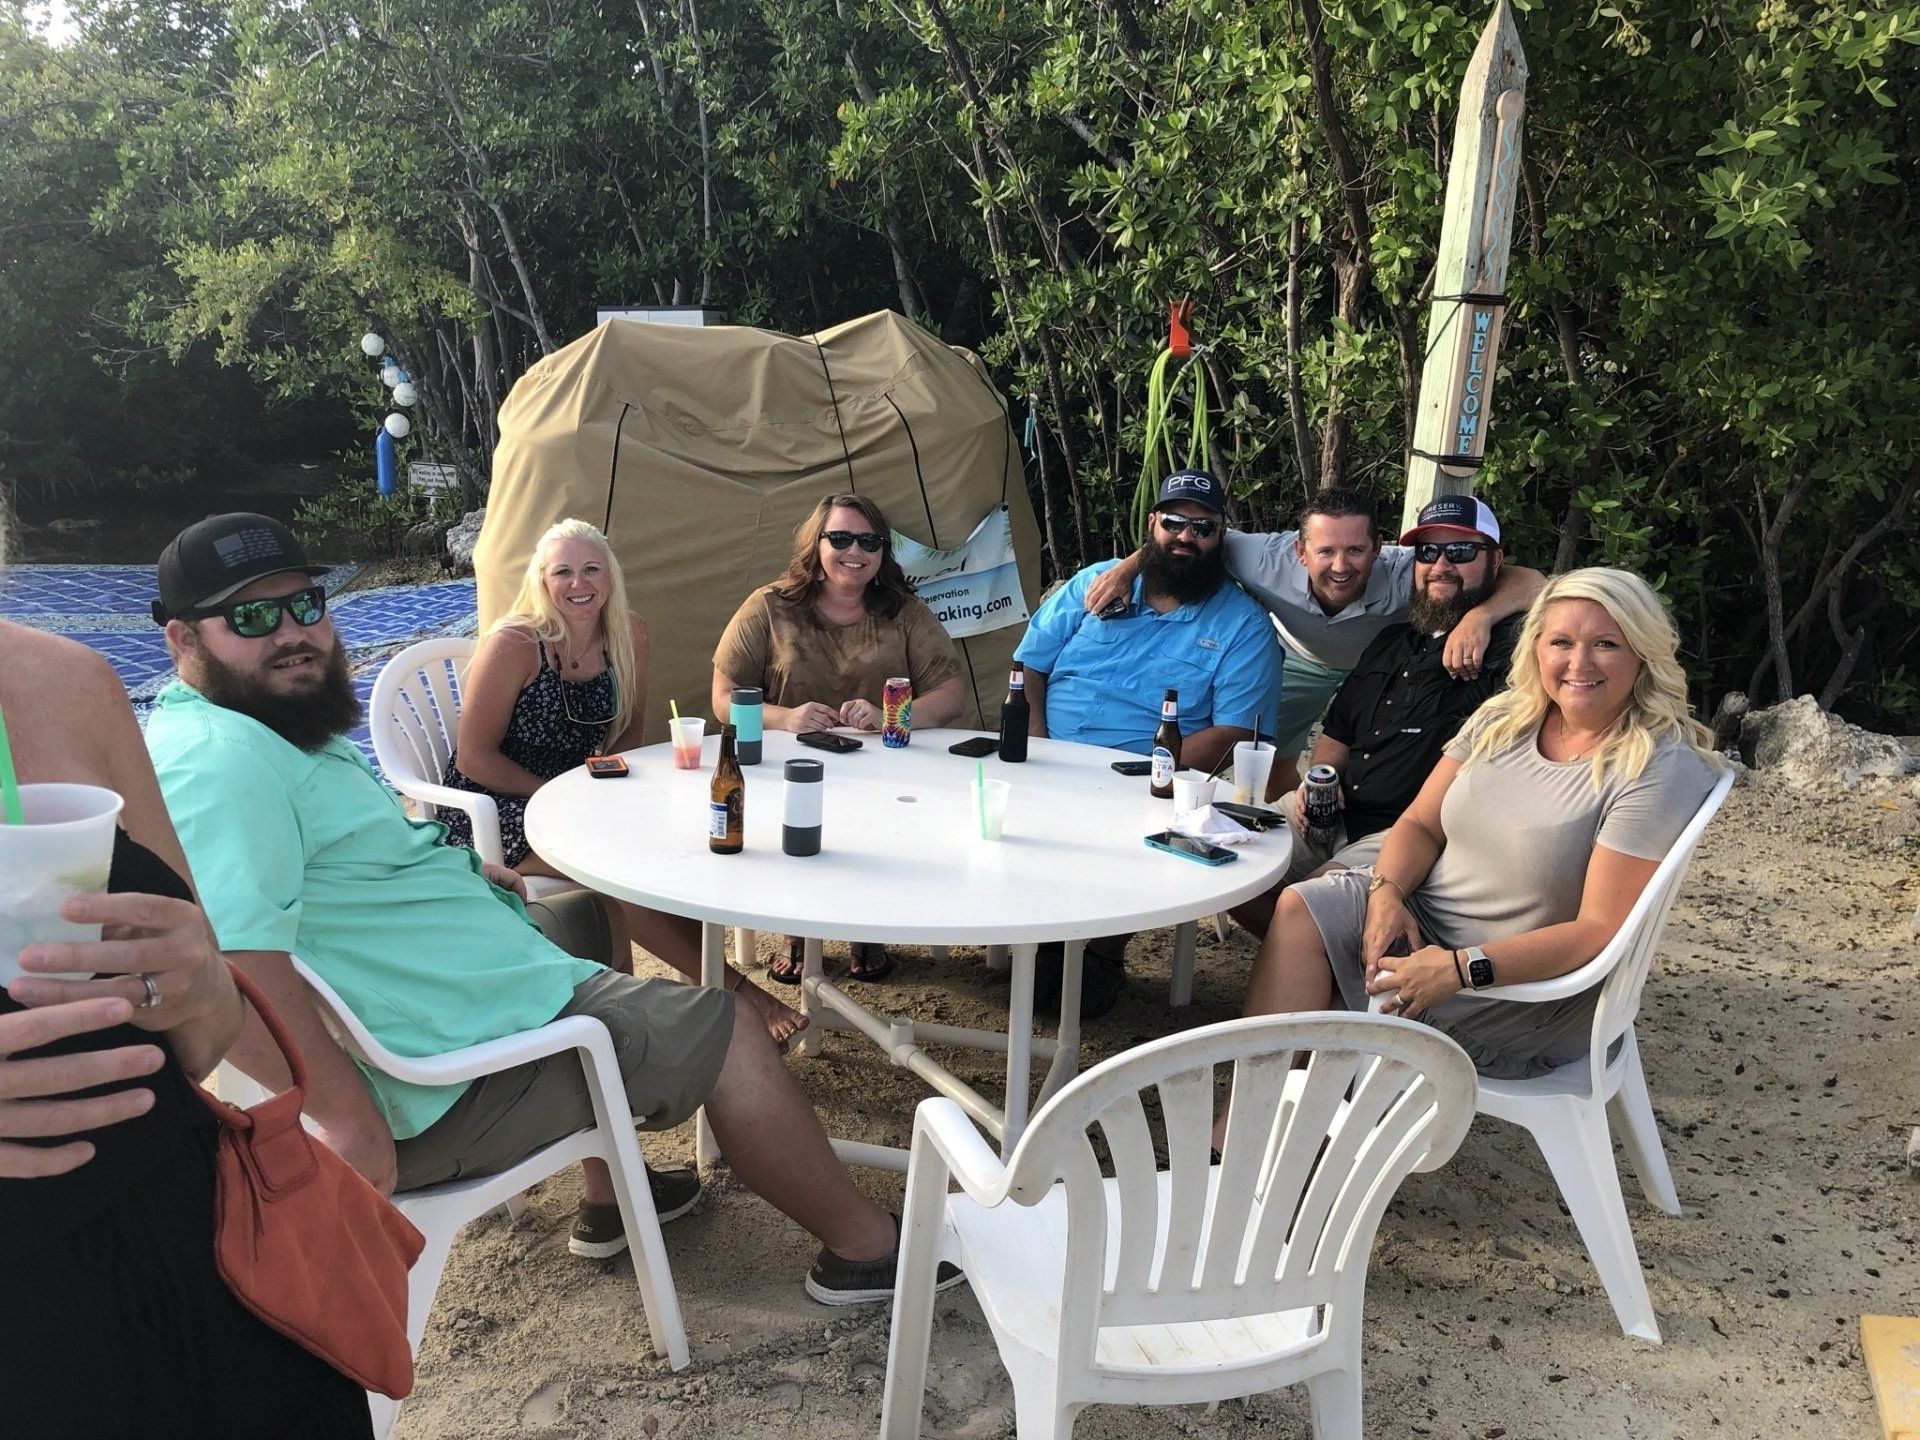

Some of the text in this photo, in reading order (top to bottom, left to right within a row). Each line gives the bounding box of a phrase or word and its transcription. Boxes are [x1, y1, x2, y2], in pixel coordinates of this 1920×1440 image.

[1458, 311, 1492, 455] WELCOME
[1168, 475, 1211, 490] PFG
[935, 595, 1012, 622] aking.com
[1152, 761, 1173, 771] LTRA
